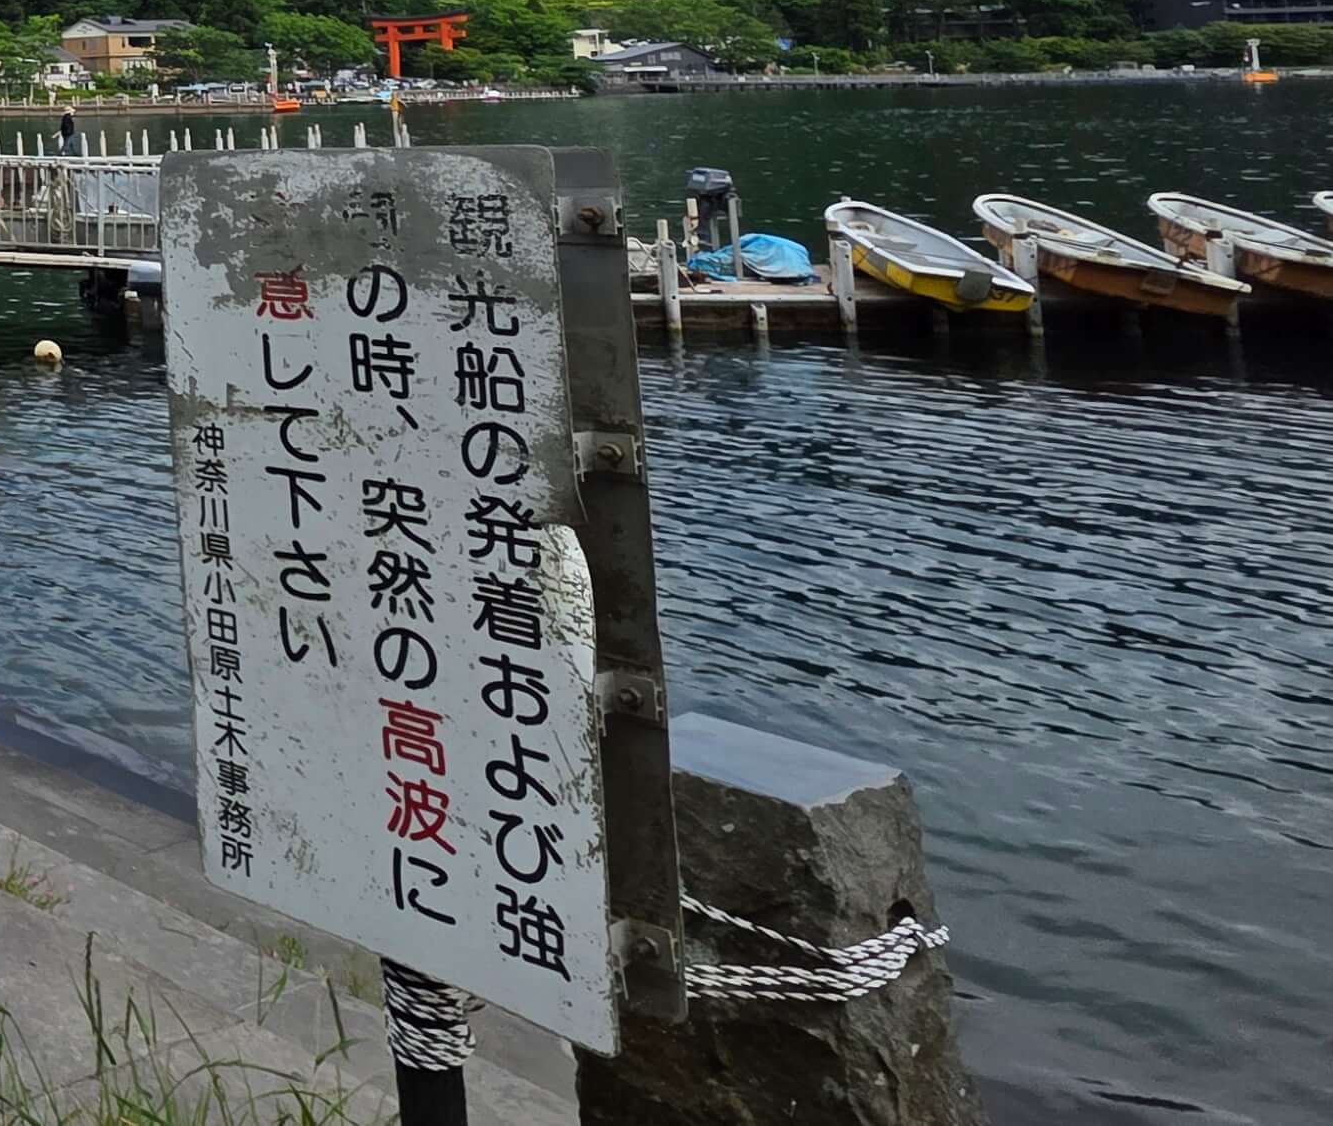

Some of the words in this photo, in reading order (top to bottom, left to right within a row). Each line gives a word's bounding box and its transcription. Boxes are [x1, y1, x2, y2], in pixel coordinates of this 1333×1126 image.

[192, 422, 254, 878] 神奈川県小田原土木事務所
[248, 191, 338, 668] 意して下さい
